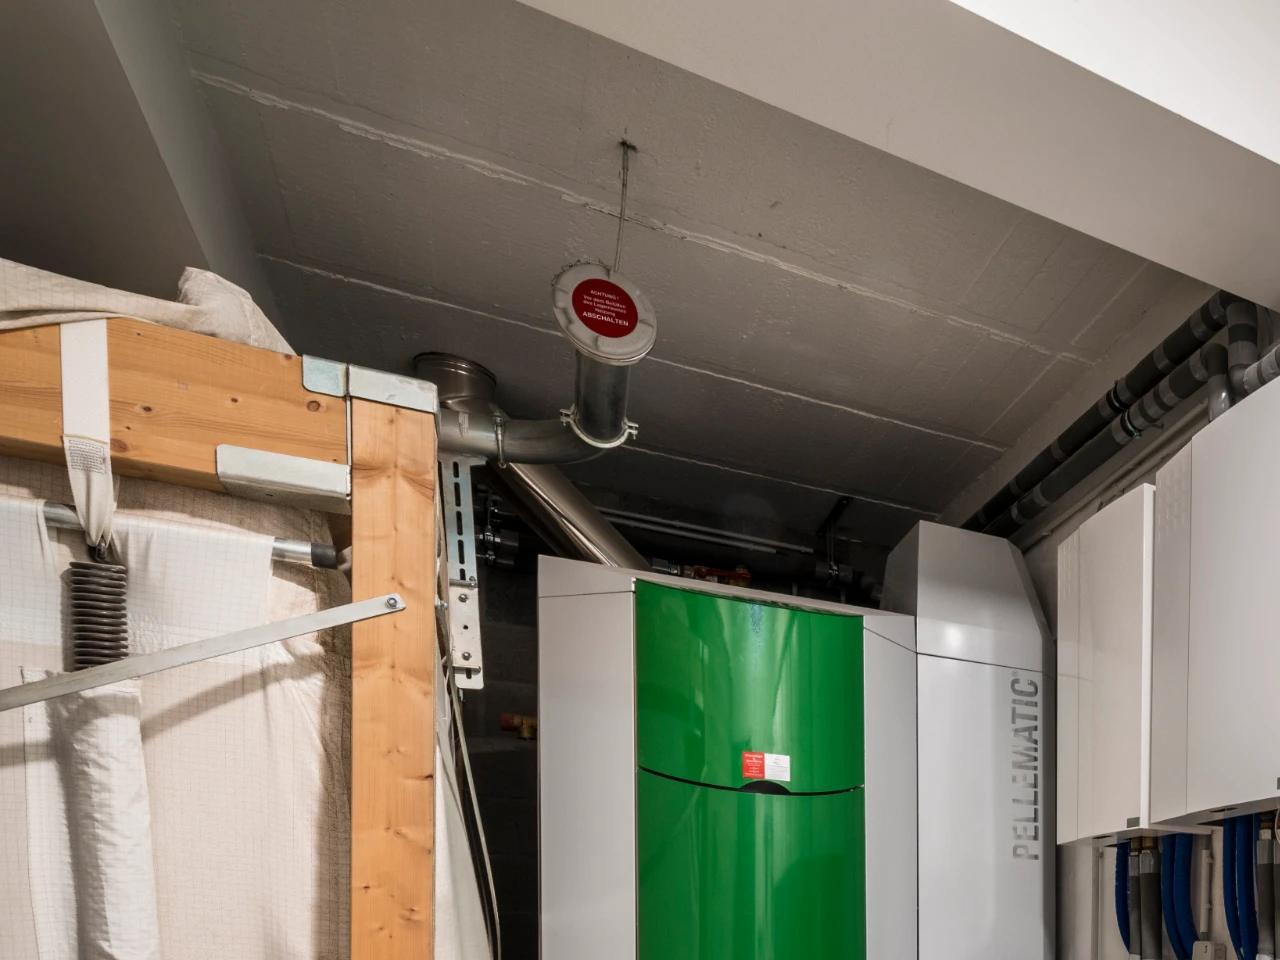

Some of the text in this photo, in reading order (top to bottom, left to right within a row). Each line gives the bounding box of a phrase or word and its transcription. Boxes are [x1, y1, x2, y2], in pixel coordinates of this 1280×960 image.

[590, 290, 616, 300] ACHTUNG
[583, 311, 628, 326] ABSCHALTEN
[1204, 945, 1208, 953] 3
